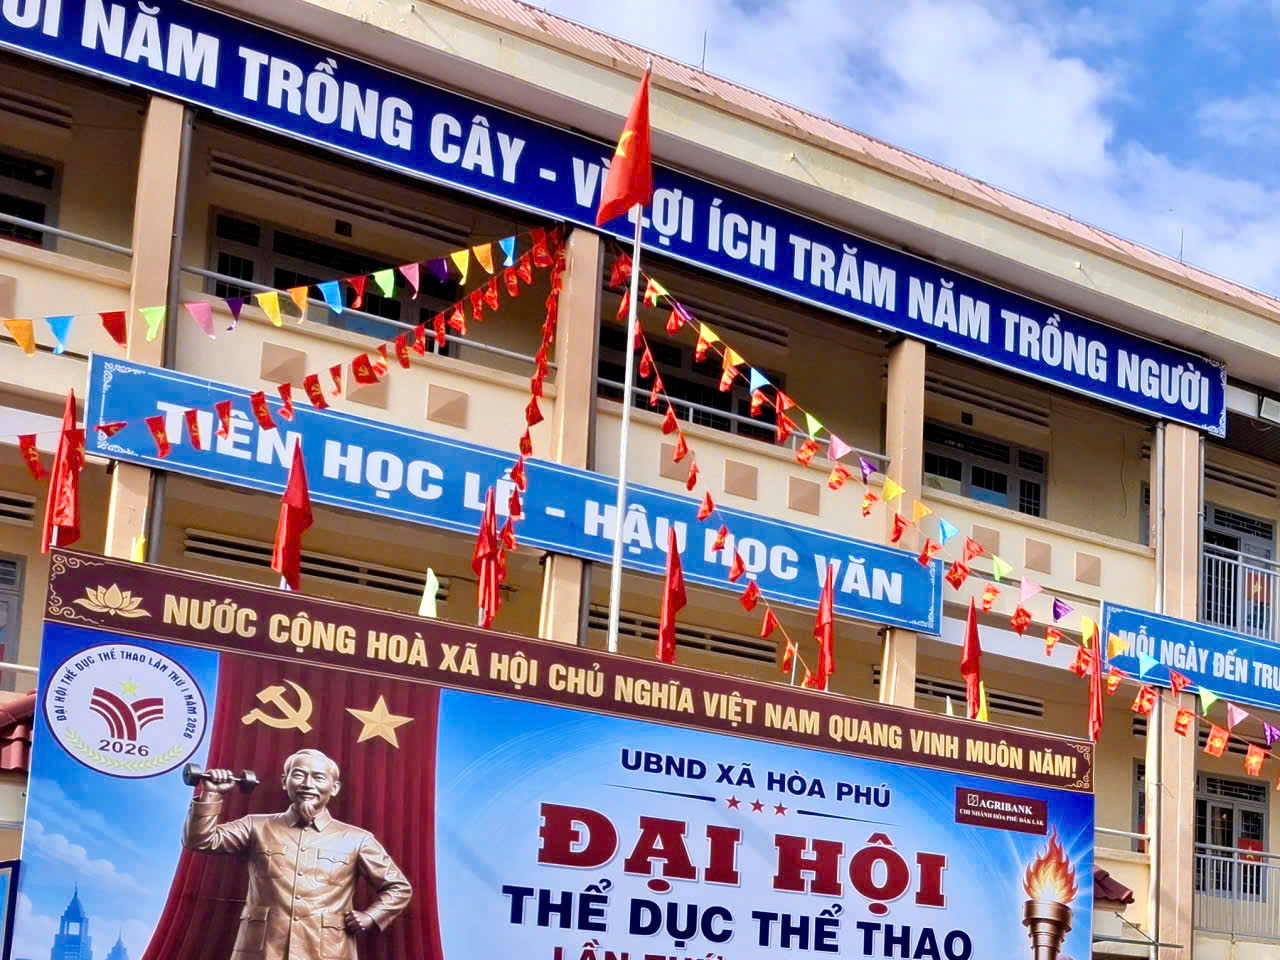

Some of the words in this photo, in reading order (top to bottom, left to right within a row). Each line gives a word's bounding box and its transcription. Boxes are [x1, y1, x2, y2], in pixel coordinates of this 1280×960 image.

[81, 0, 219, 88] NĂM
[239, 46, 413, 150] TRỒNG
[430, 113, 526, 184] CÂY
[708, 198, 776, 271] ÍCH
[789, 234, 897, 312] TRĂM
[908, 279, 989, 344] NĂM
[1001, 314, 1107, 381] TRỒNG
[1117, 349, 1210, 414] NGƯỜI
[157, 401, 302, 470] TIÊN
[323, 440, 443, 499] HỌC
[584, 500, 687, 555] HẬU
[704, 528, 799, 580] HỌC
[814, 554, 902, 605] VĂN
[75, 656, 95, 671] DỤC
[120, 650, 145, 663] THAO
[183, 717, 197, 739] 2026
[163, 594, 257, 638] NƯỚC
[269, 612, 356, 654] CỘNG
[366, 632, 429, 668] HOÀ
[439, 643, 479, 676] XÃ
[489, 651, 538, 690] HỘI
[549, 662, 604, 698] CHỦ
[615, 675, 694, 713] NGHĨA
[703, 691, 756, 727] VIỆT
[765, 703, 819, 736] NAM
[829, 716, 902, 749] QUANG
[910, 729, 959, 759] VINH
[966, 740, 1023, 770] MUÔN
[1029, 749, 1077, 779] NĂM!
[1118, 625, 1155, 659] MỖI
[1160, 640, 1208, 674] NGÀY
[1213, 648, 1248, 684] ĐẾN
[98, 739, 149, 757] 2026
[620, 748, 707, 780] UBND
[716, 761, 756, 789] XÃ
[767, 768, 826, 798] HÒA
[837, 781, 891, 808] PHÚ
[979, 799, 1033, 815] AGRIBANK
[537, 802, 742, 893] ĐẠI
[773, 832, 947, 915] HỘI
[502, 877, 612, 932] THỂ
[628, 898, 734, 950] DỤC
[751, 903, 843, 954] THỂ
